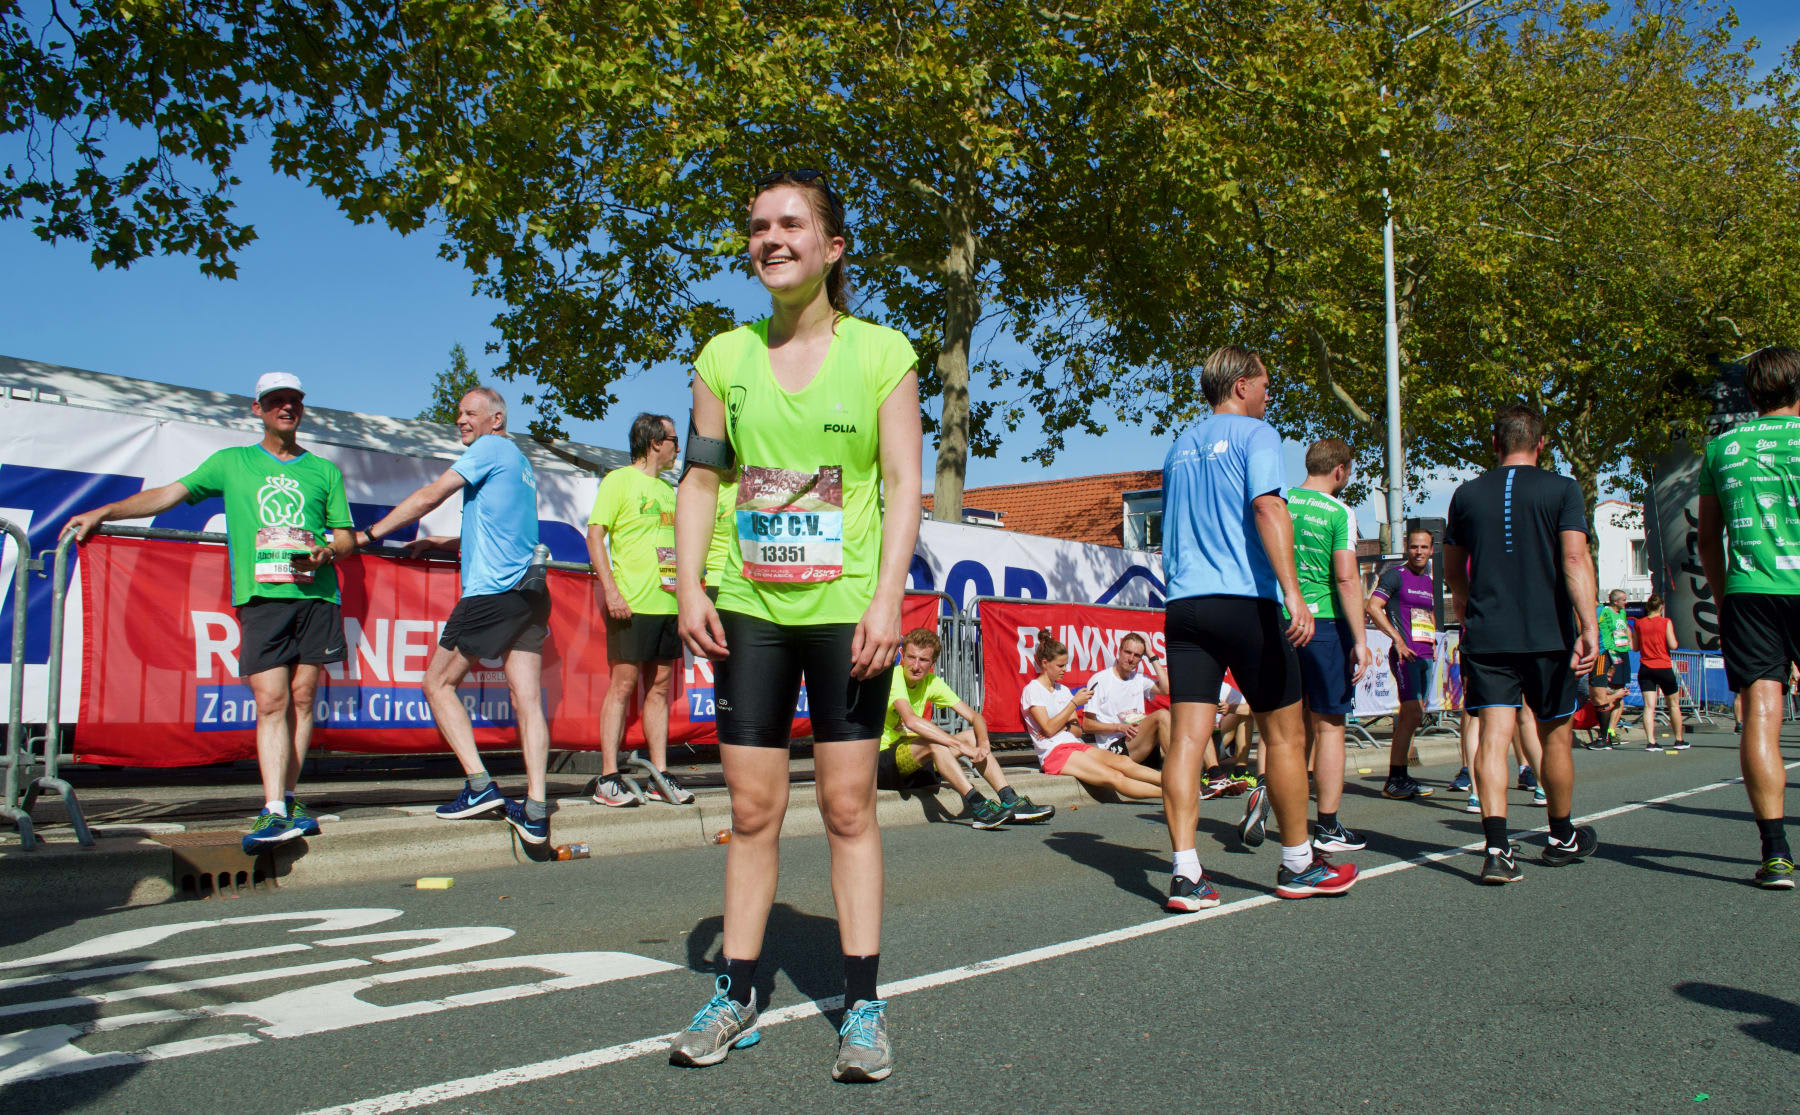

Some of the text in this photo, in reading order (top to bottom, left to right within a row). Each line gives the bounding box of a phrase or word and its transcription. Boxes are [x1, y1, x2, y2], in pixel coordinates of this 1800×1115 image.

[824, 424, 856, 433] FOLIA
[787, 514, 824, 537] C.V.
[761, 546, 806, 562] 13351
[201, 692, 357, 723] Zanort
[368, 692, 433, 721] Circu
